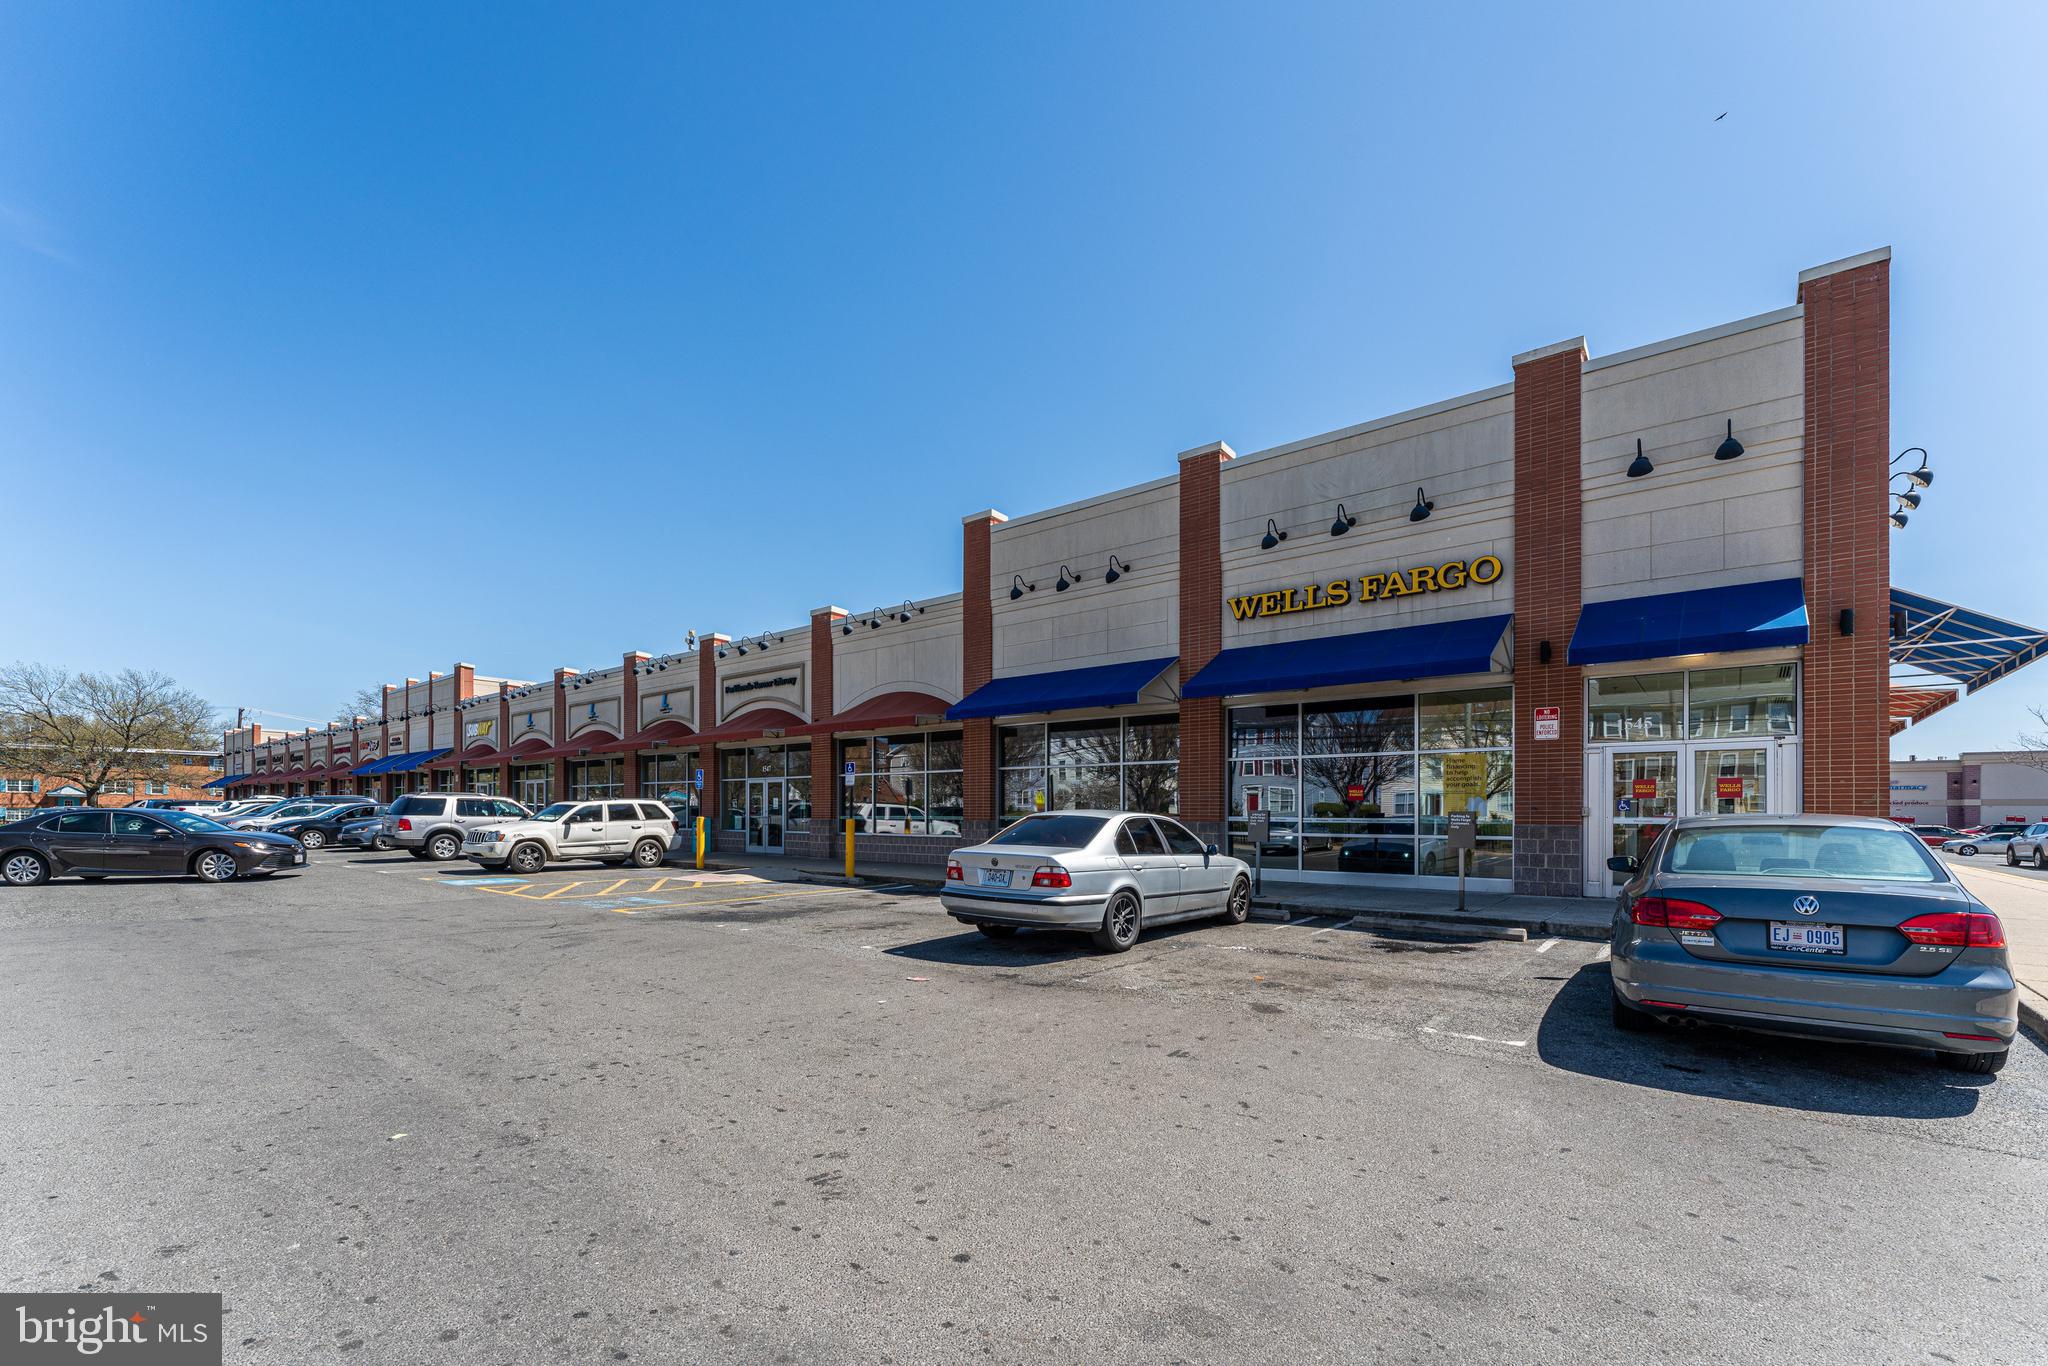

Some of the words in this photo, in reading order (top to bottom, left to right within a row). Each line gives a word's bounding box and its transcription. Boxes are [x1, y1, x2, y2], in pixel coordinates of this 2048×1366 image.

[1227, 578, 1351, 621] WELLS
[1358, 555, 1504, 603] FARGO
[467, 720, 493, 738] SUBWAY
[1773, 927, 1789, 942] EJ
[1806, 929, 1840, 946] 0905
[1785, 945, 1828, 954] CarCenter
